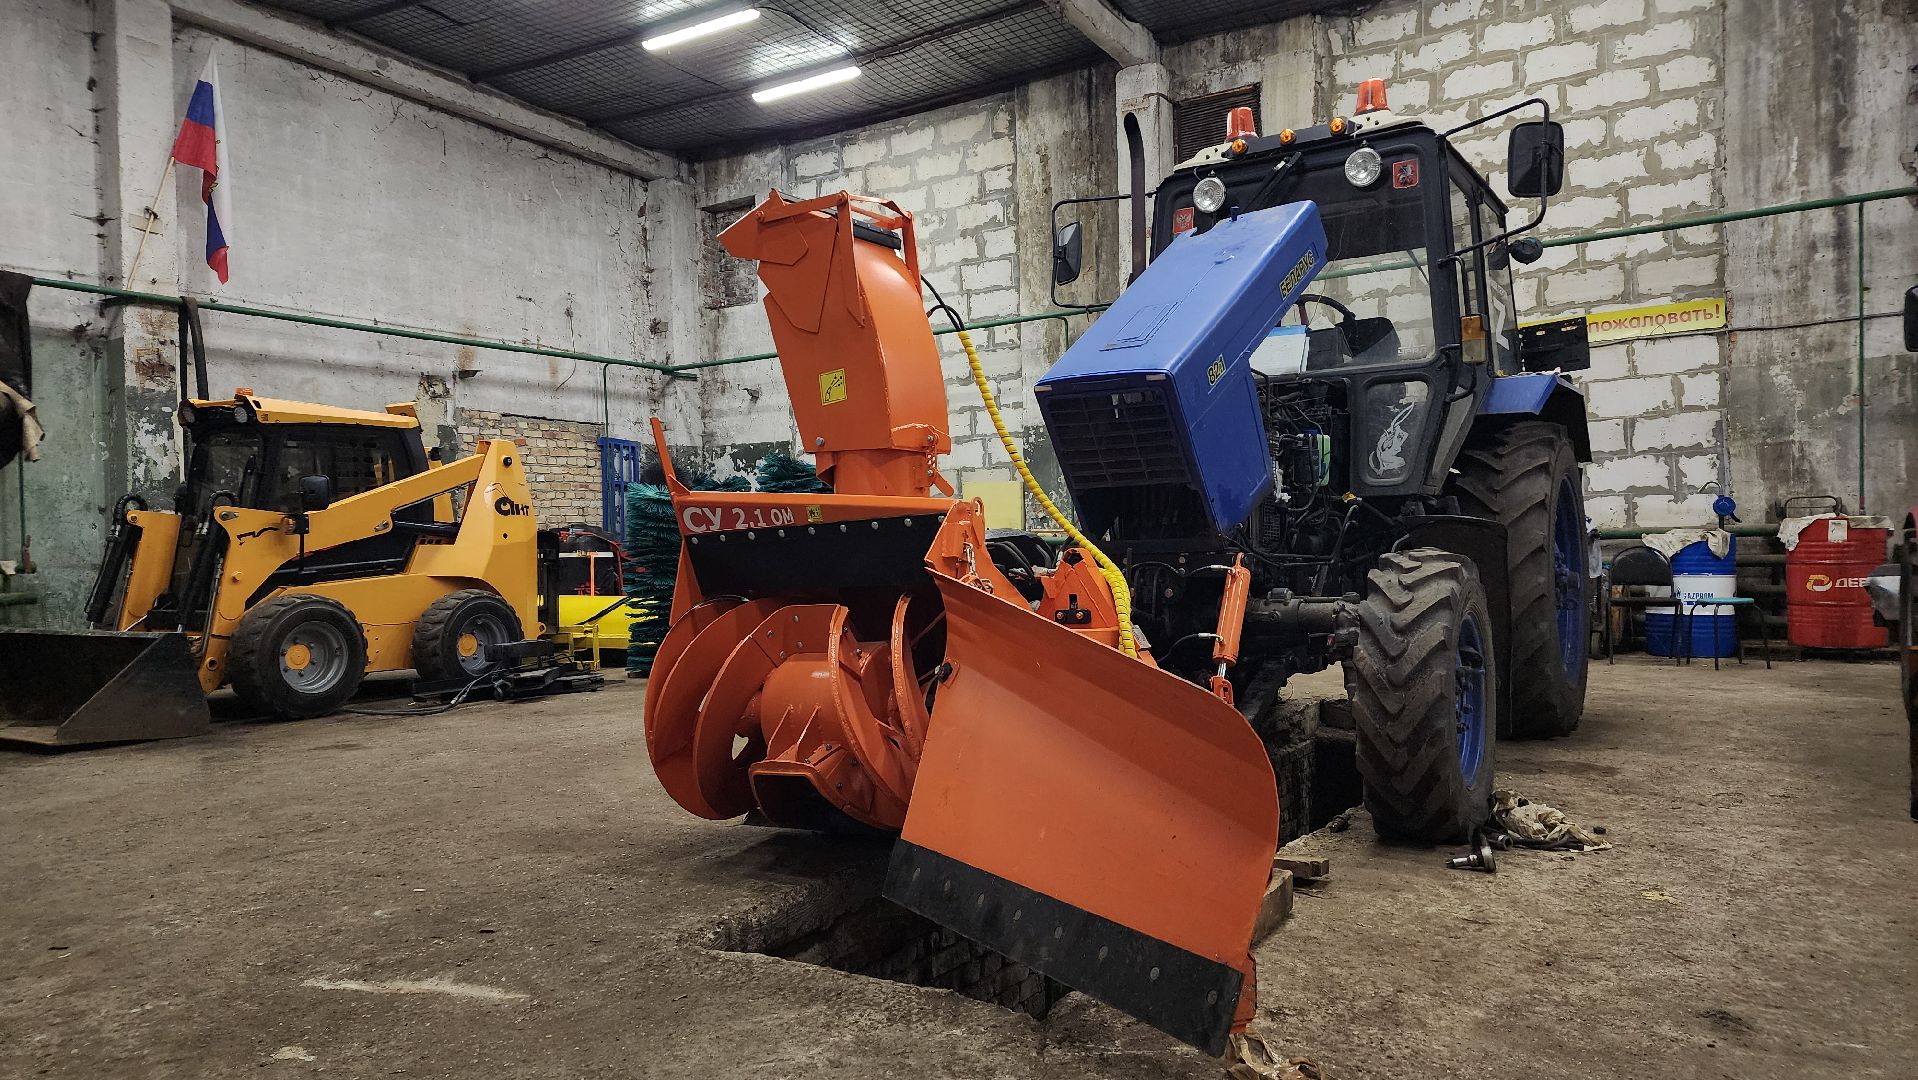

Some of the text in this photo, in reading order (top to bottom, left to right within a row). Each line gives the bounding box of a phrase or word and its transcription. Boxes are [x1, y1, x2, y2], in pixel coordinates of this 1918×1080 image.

[1588, 303, 1720, 334] пожаловать!
[682, 506, 795, 533] СУ 2.1 ОМ
